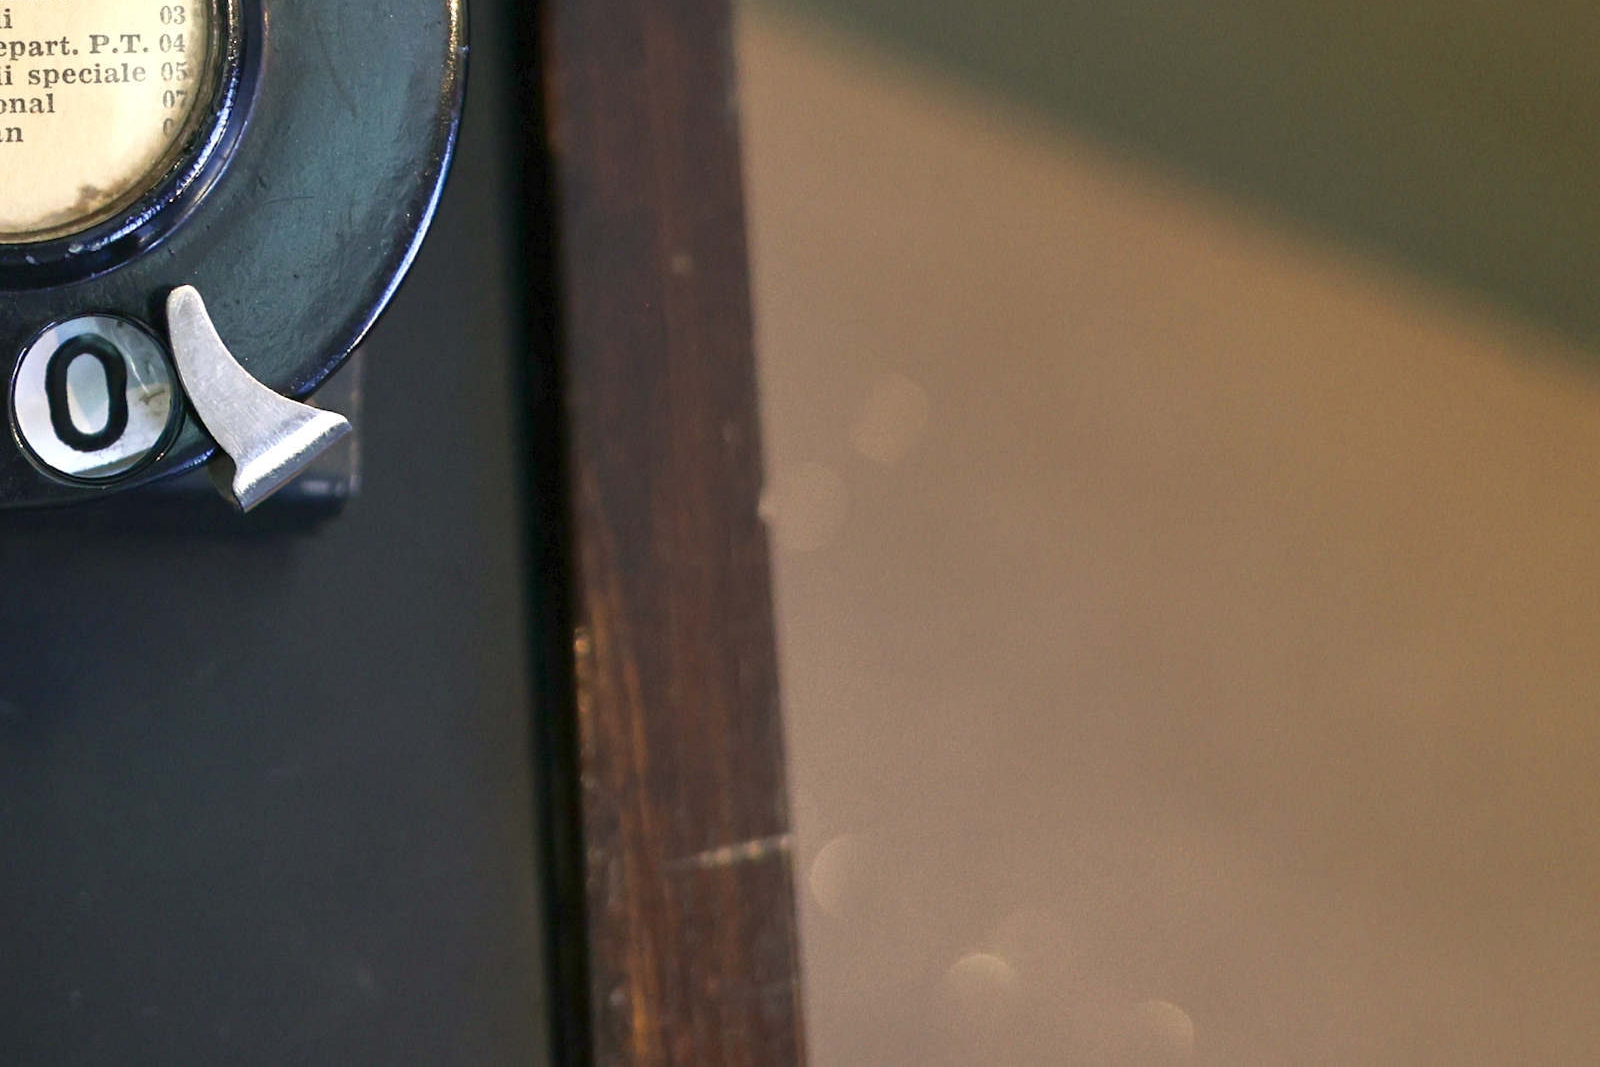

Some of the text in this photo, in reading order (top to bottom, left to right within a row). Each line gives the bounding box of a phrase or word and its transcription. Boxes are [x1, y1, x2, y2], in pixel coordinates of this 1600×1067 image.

[159, 5, 186, 25] 03
[88, 33, 149, 55] P.T.
[158, 33, 186, 53] 04
[27, 62, 147, 89] speciale
[160, 61, 188, 82] 05
[44, 333, 129, 453] 0
